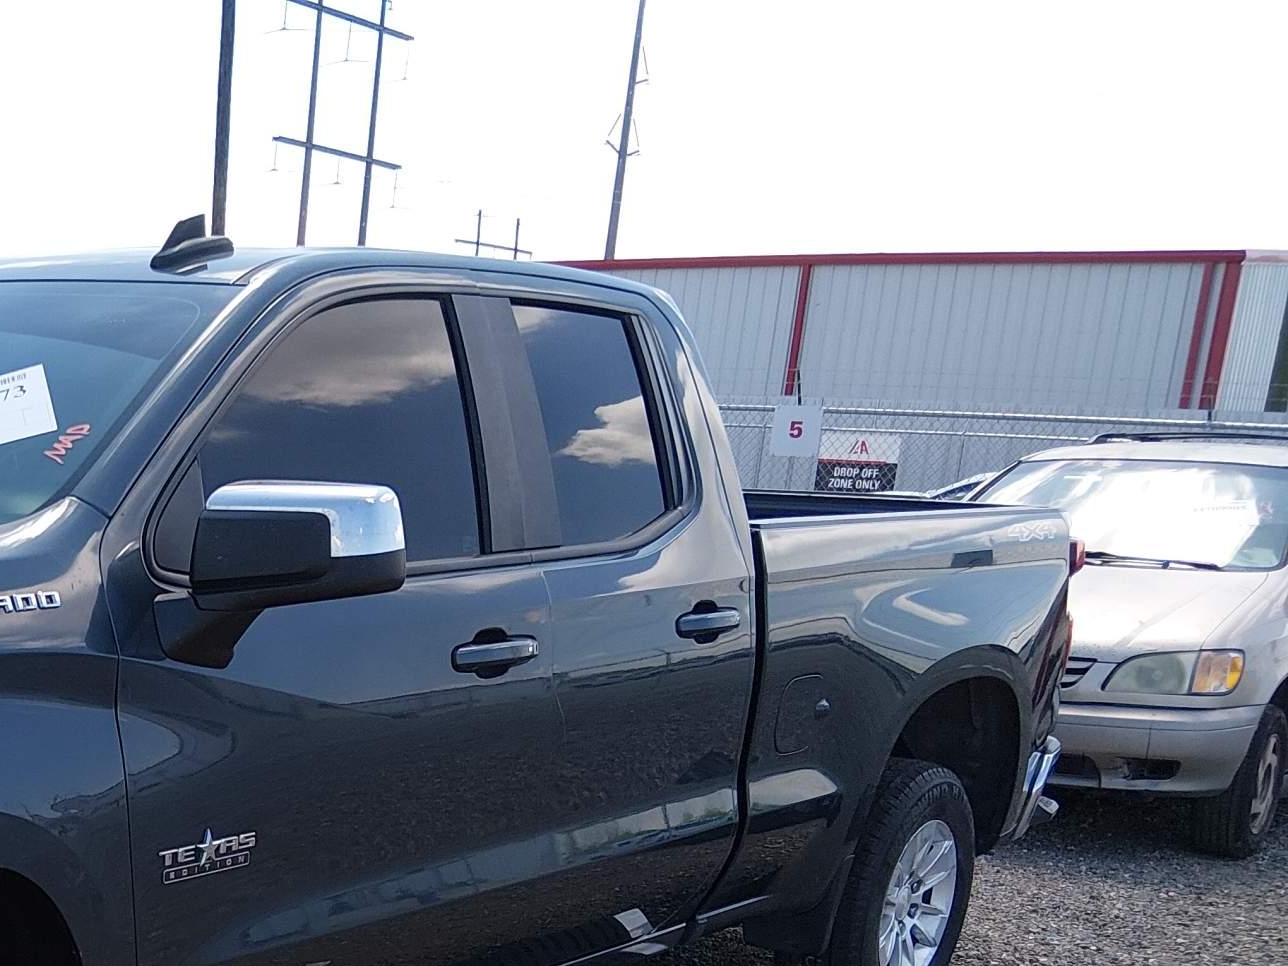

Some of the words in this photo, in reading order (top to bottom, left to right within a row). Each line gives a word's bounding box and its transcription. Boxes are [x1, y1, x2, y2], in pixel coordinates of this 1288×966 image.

[789, 420, 803, 439] 5
[833, 466, 860, 478] DROP
[861, 468, 880, 479] OFF
[827, 478, 854, 489] ZONE
[855, 479, 881, 490] ONLY
[159, 828, 257, 867] TEXAS
[169, 856, 245, 880] EDITION
